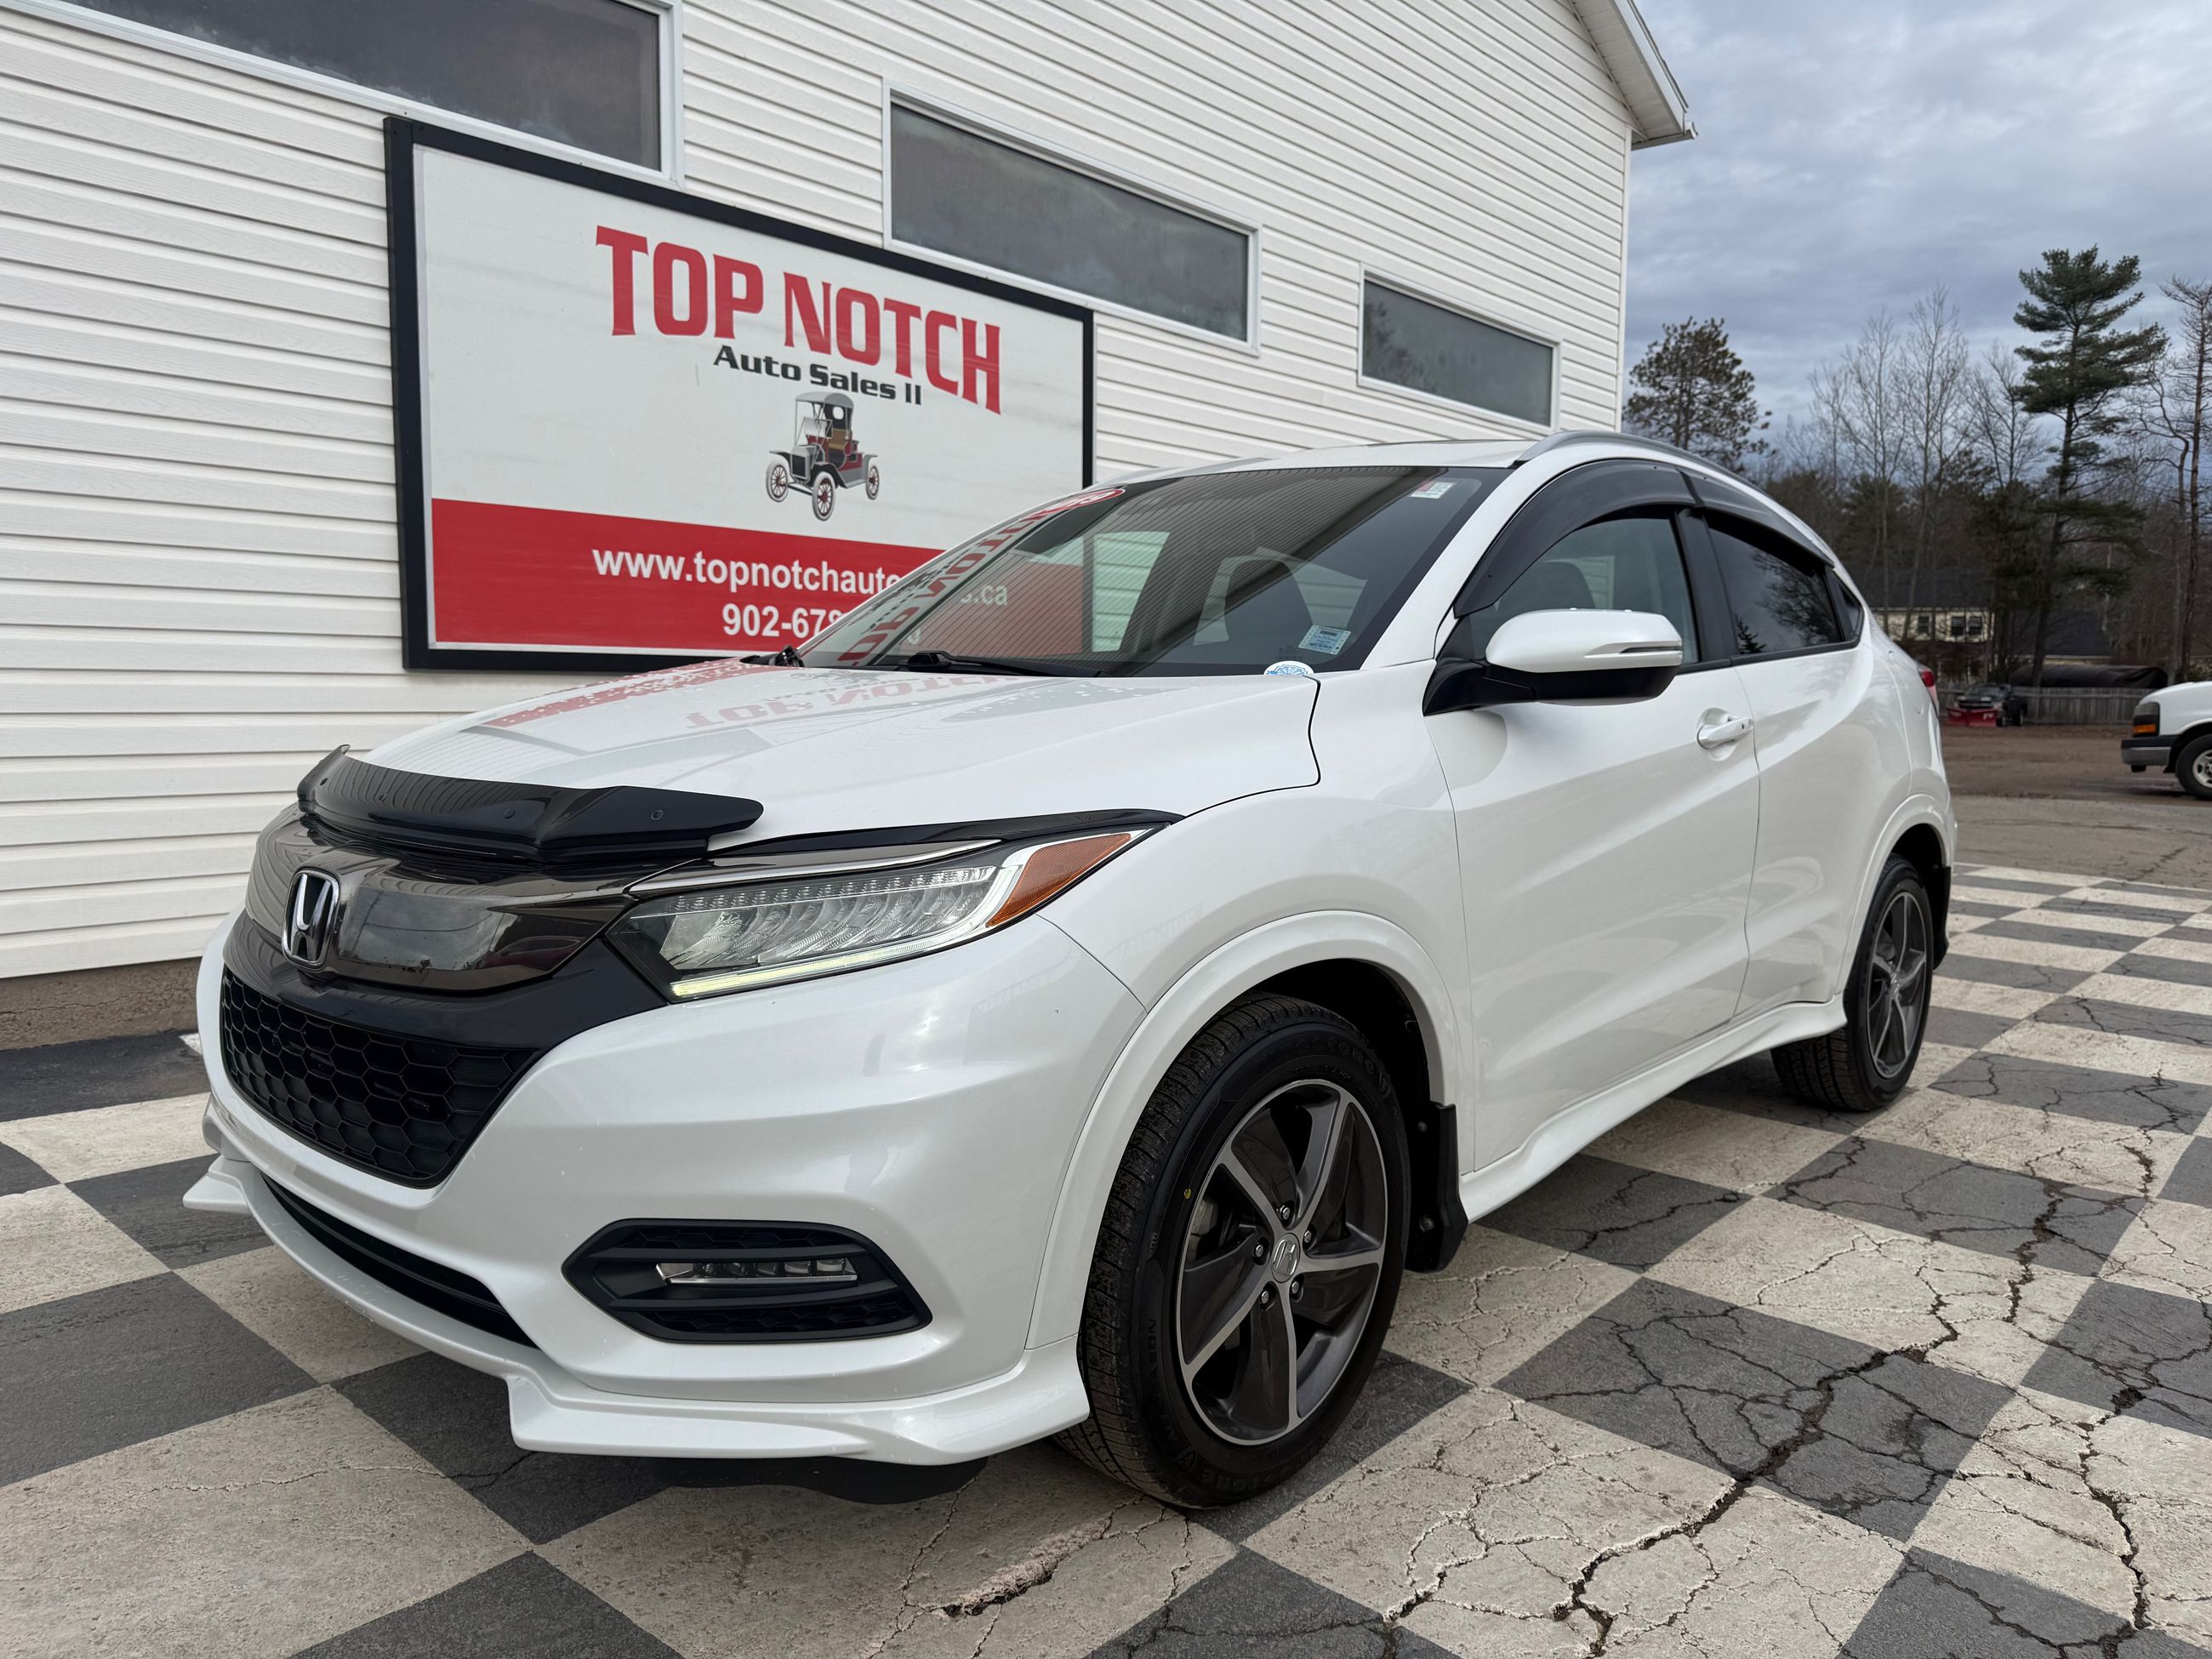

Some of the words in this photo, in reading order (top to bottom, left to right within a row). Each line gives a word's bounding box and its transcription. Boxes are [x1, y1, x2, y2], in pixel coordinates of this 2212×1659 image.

[596, 225, 764, 339] TOP
[784, 272, 1001, 415] NOTCH
[713, 345, 801, 381] Auto
[810, 363, 897, 400] Sales
